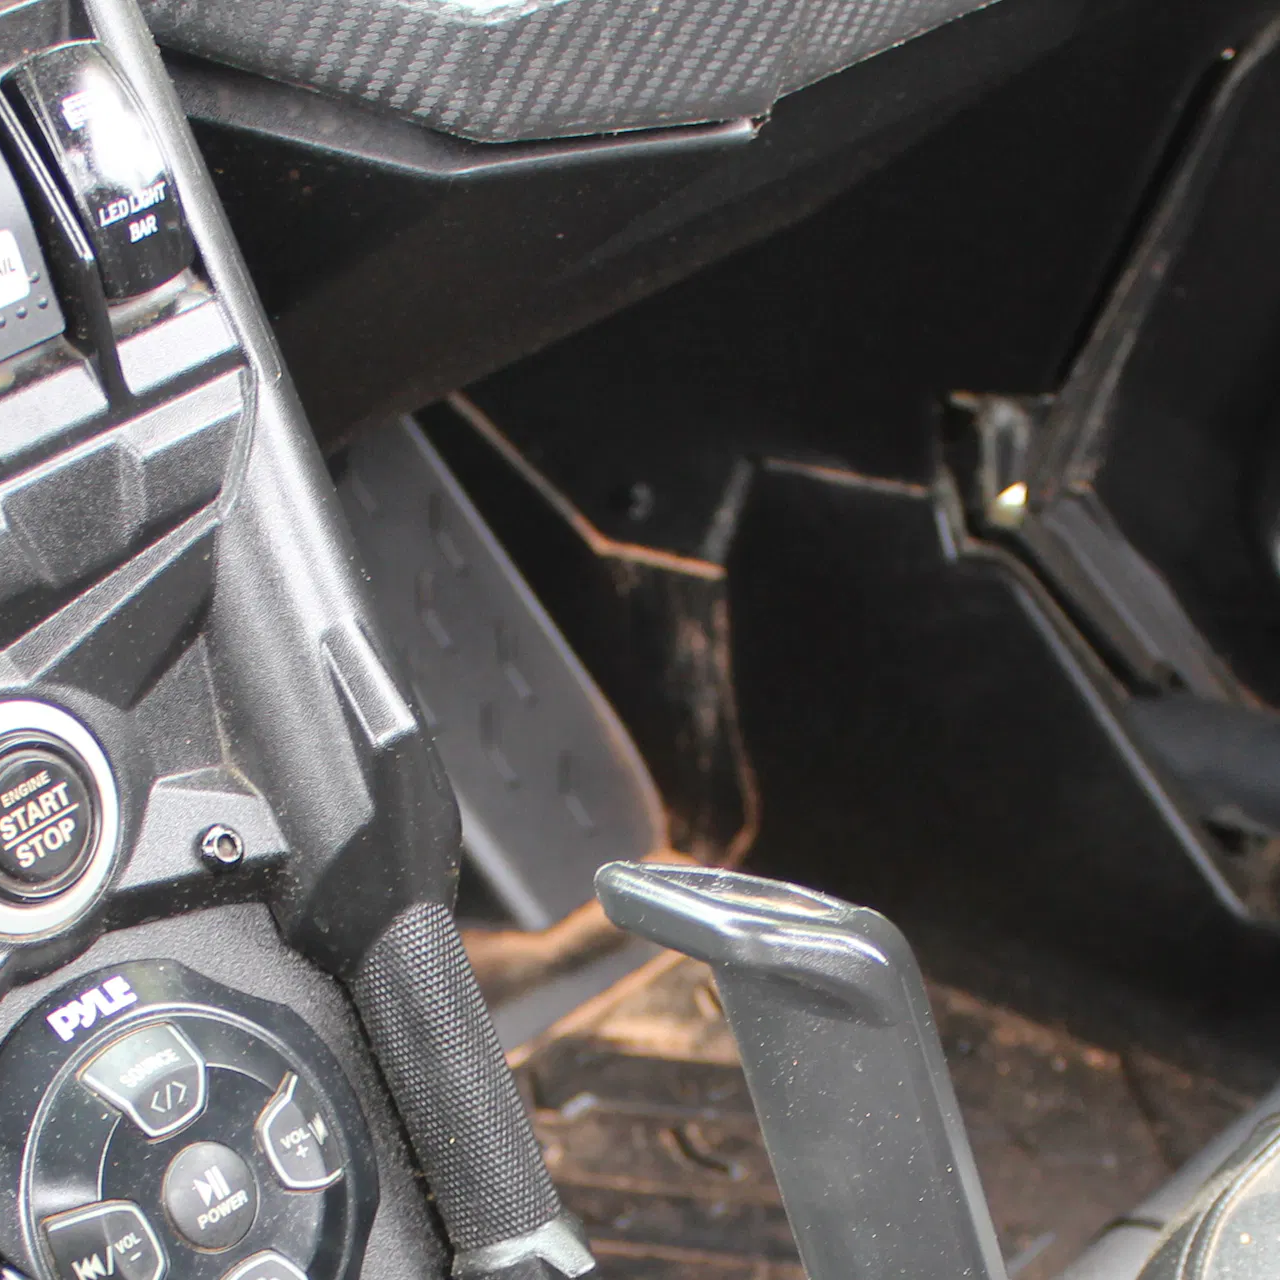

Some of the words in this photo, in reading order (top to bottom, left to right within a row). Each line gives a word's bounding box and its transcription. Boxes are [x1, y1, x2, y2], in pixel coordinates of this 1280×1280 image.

[98, 196, 129, 227] LED
[129, 181, 167, 214] LIGHT
[128, 214, 158, 243] BAR
[0, 769, 51, 808] ENGINE
[15, 818, 76, 869] STOP
[120, 1047, 181, 1088] SOURCE
[279, 1127, 311, 1149] VOL
[196, 1189, 249, 1230] POWER
[114, 1232, 143, 1254] VOL
